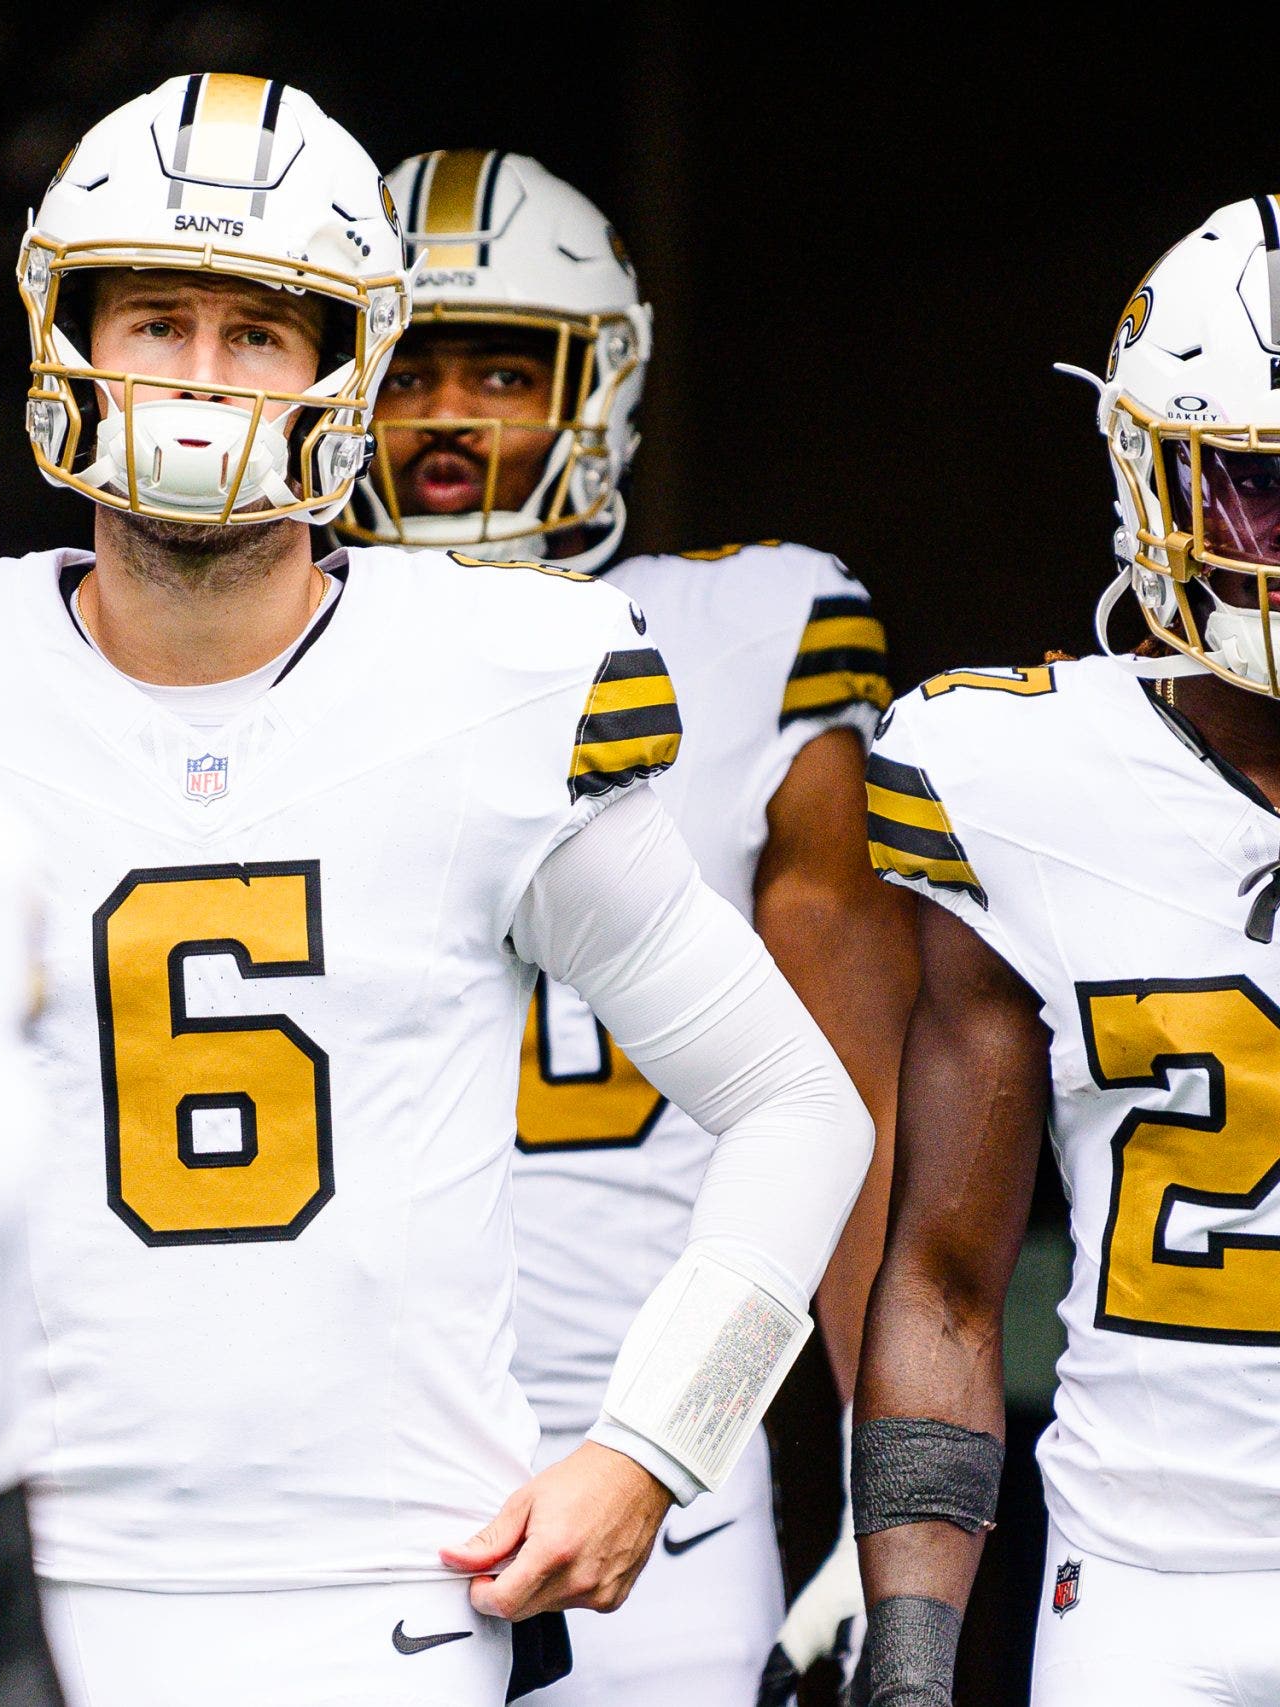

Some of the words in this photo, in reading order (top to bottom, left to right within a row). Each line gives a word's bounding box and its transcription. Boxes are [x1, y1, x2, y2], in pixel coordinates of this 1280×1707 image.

[174, 214, 244, 237] SAINTS
[1167, 411, 1218, 422] OAKLEY
[190, 772, 223, 794] NFL
[92, 859, 336, 1248] 6
[1075, 974, 1280, 1347] 2
